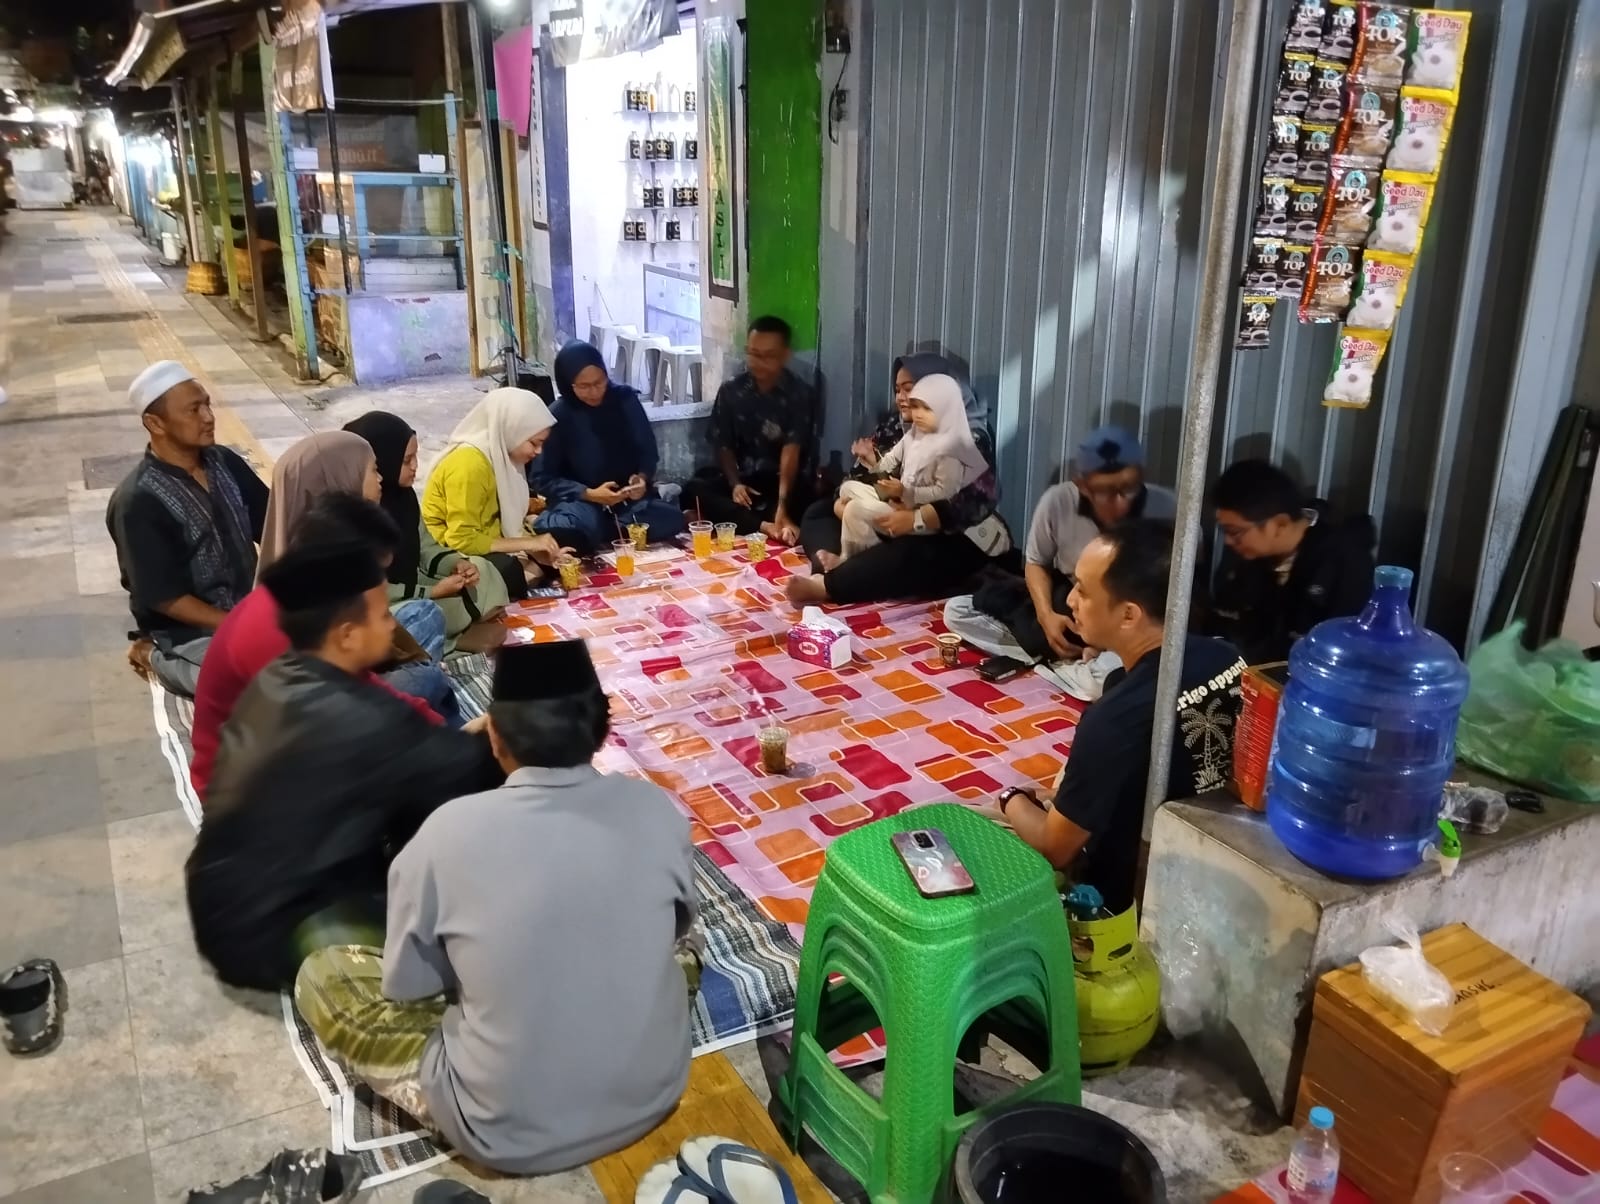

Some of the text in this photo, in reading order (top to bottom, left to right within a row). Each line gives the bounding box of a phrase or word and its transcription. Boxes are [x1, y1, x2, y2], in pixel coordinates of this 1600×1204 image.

[1299, 5, 1325, 17] TOP
[1332, 14, 1356, 27] TOP
[1415, 14, 1463, 33] Good Day
[1366, 25, 1402, 42] TOP
[1289, 69, 1311, 81] TOP
[1318, 78, 1342, 90] TOP
[1401, 101, 1448, 118] Good Day
[1354, 109, 1385, 125] TOP
[1277, 133, 1299, 145] TOP
[1304, 141, 1329, 153] TOP
[1335, 187, 1371, 202] TOP
[1382, 183, 1427, 200] Good Day
[1267, 193, 1288, 206] TOP
[1293, 201, 1318, 212] TOP
[1258, 254, 1280, 264] TOP
[1283, 260, 1306, 271] TOP
[1317, 261, 1355, 276] TOP
[1363, 263, 1405, 280] Good Day
[1247, 311, 1271, 323] TOP
[1340, 339, 1379, 353] Good Day
[1176, 685, 1208, 712] rigo
[1454, 979, 1495, 1005] JASUK
